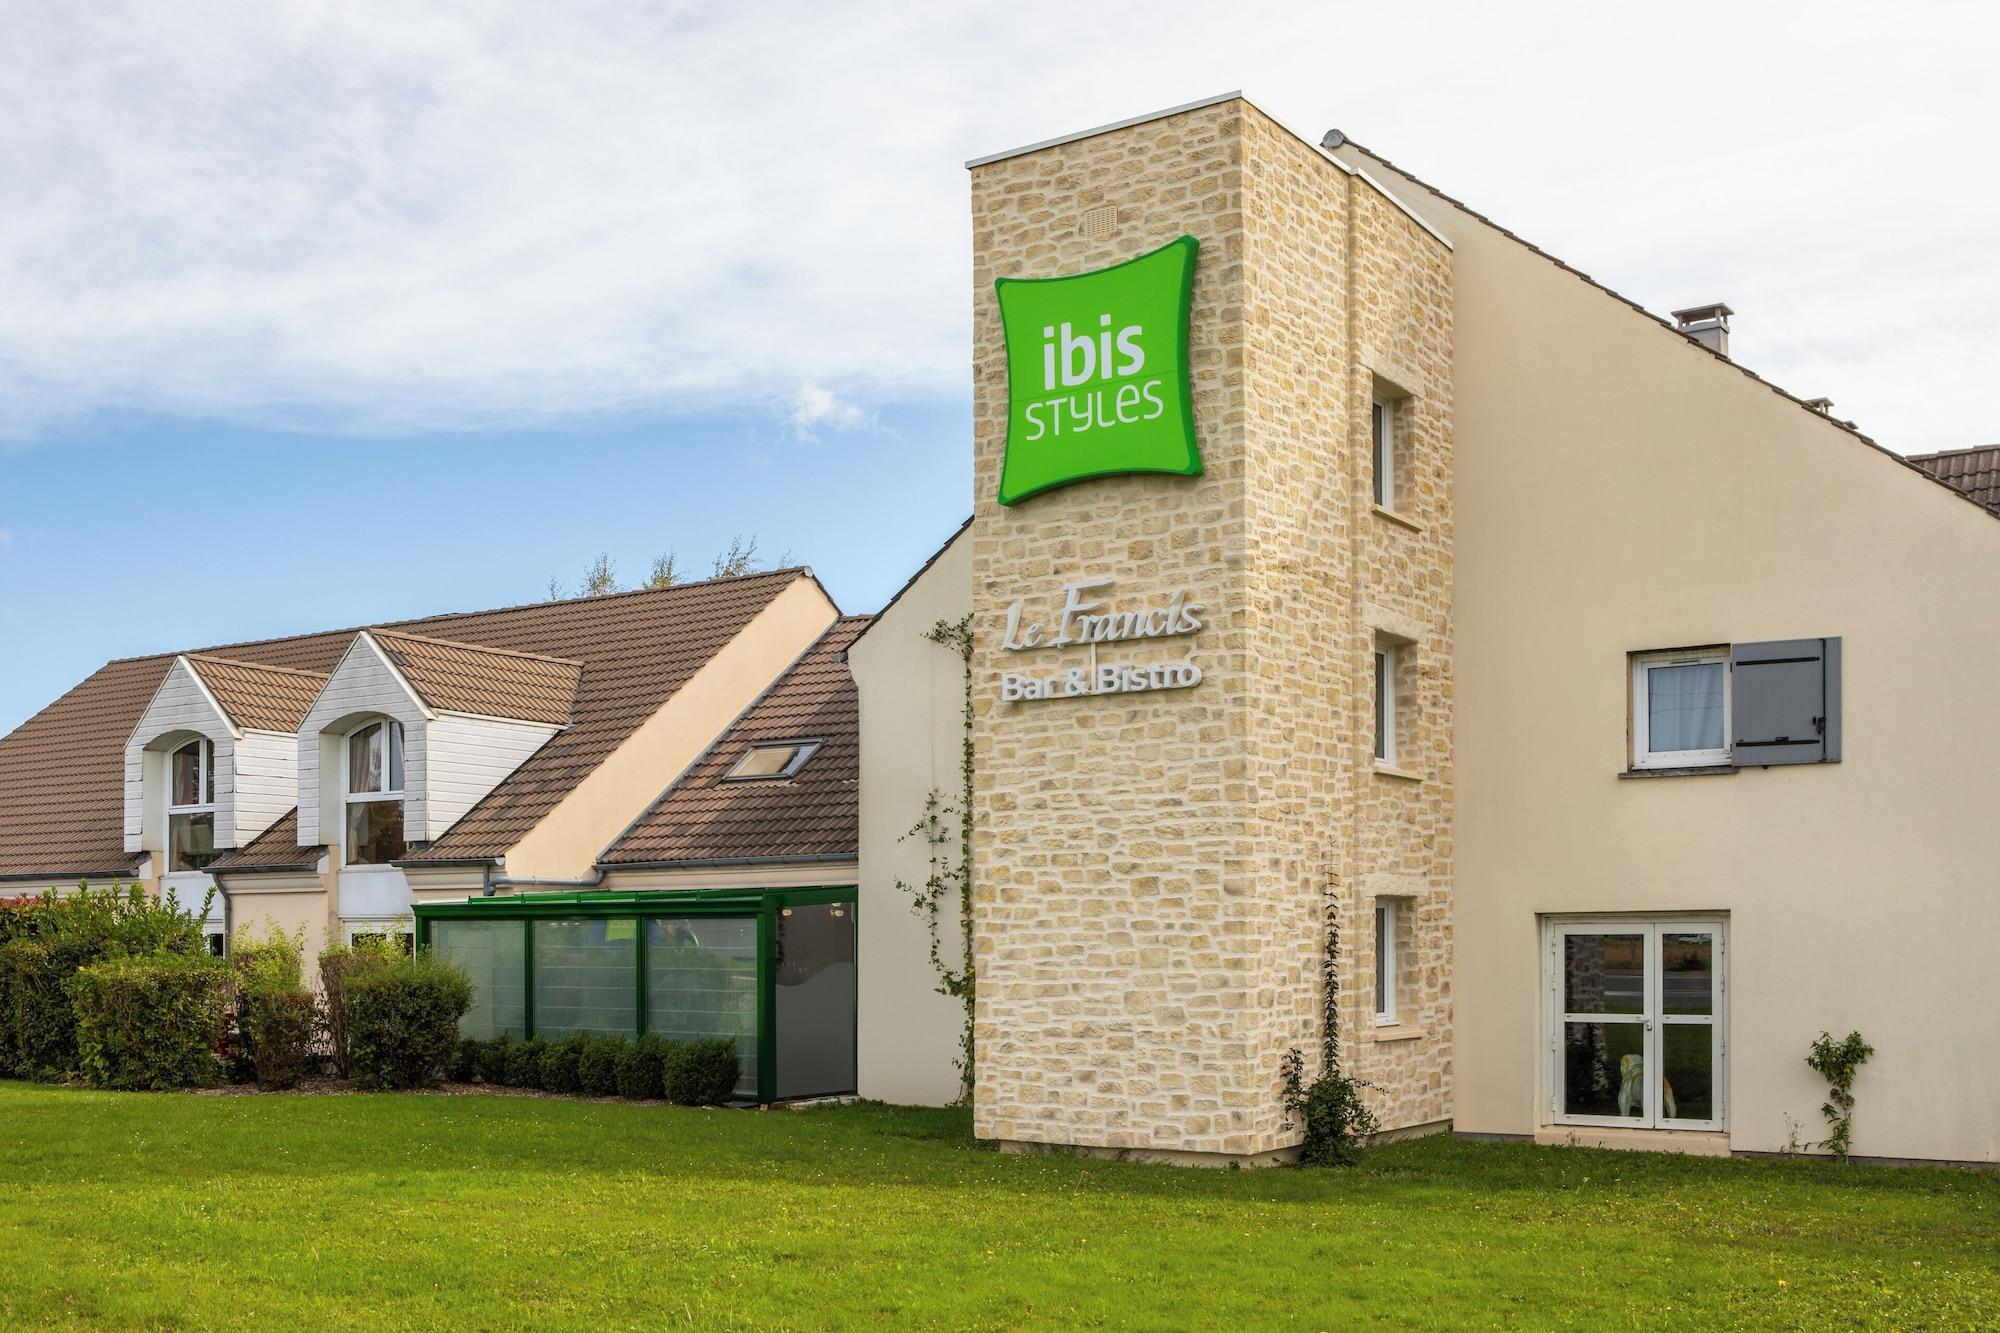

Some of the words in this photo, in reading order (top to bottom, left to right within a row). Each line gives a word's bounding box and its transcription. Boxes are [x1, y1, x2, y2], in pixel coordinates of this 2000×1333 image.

[1043, 313, 1145, 390] ibis
[1001, 601, 1044, 650] Le
[1050, 579, 1204, 644] Francis
[1002, 673, 1056, 700] Bar
[1065, 667, 1089, 695] &
[1098, 661, 1202, 693] Bistro
